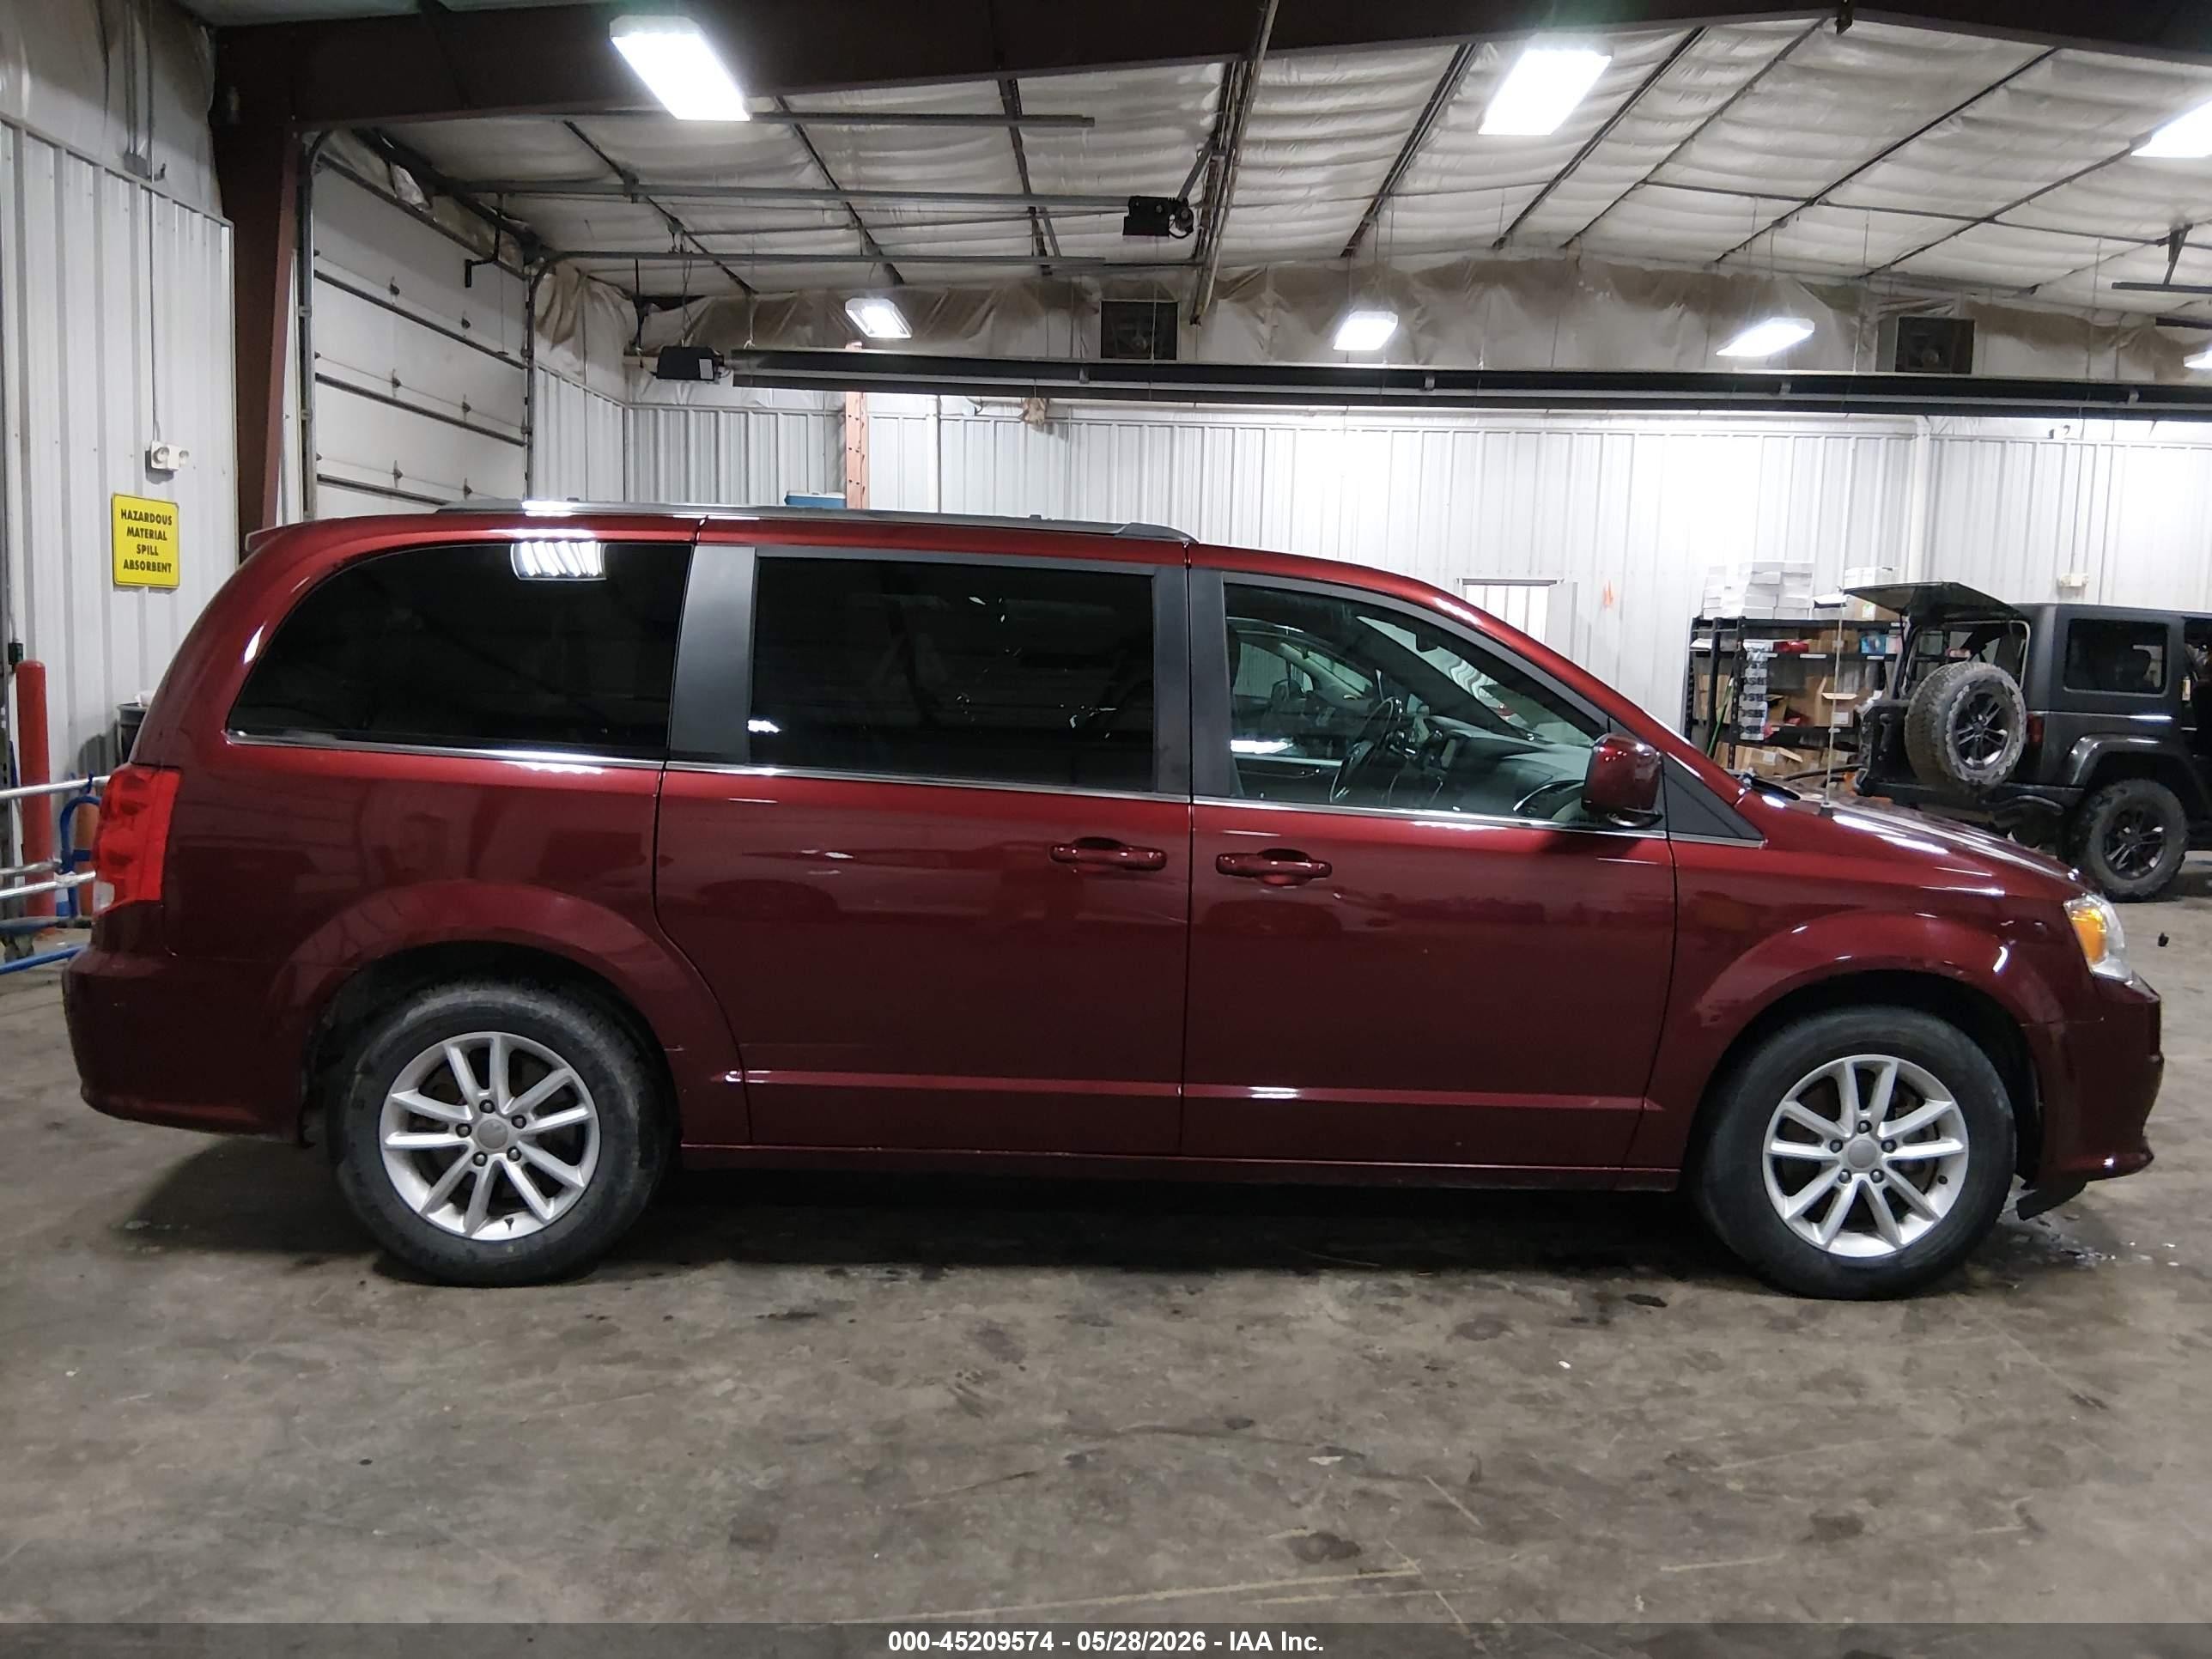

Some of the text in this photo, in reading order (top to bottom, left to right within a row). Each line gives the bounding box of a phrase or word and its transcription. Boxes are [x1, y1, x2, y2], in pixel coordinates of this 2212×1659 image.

[120, 508, 173, 526] HAZARDOUS
[126, 526, 167, 541] MATERIAL
[136, 544, 159, 556] SPILL
[123, 559, 172, 574] ABSORBENT
